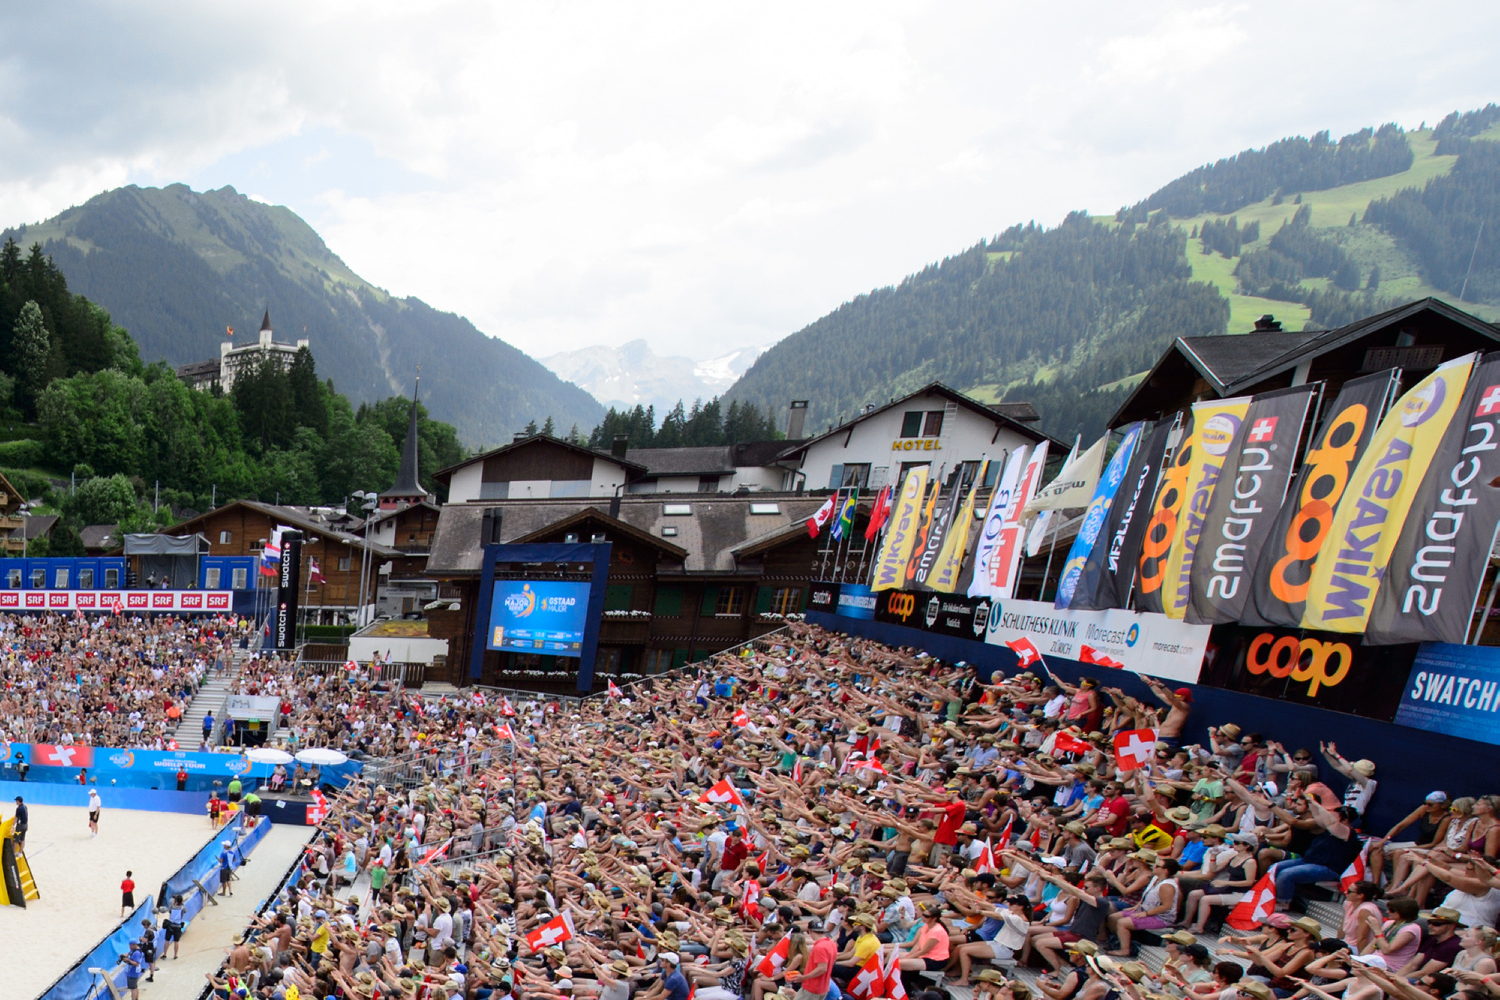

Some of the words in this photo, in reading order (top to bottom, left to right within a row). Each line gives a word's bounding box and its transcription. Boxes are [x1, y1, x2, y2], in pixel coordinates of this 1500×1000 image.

[892, 439, 942, 451] HOTEL
[281, 549, 291, 588] swatch
[1, 595, 18, 604] SRF
[27, 595, 44, 604] SRF
[51, 595, 68, 604] SRF
[77, 595, 94, 604] SRF
[129, 595, 146, 605] SRF
[154, 595, 172, 605] SRF
[182, 596, 201, 605] SRF
[209, 596, 227, 605] SRF
[549, 597, 576, 606] GSTAAD
[888, 592, 915, 623] coop
[278, 609, 287, 648] swatch
[1000, 612, 1048, 634] SCHULTHESS
[1048, 619, 1079, 638] KLINIK
[1085, 623, 1127, 645] Morecast
[1050, 639, 1073, 655] ZÜRICH
[1246, 633, 1352, 697] coop
[1411, 670, 1500, 713] SWATCH
